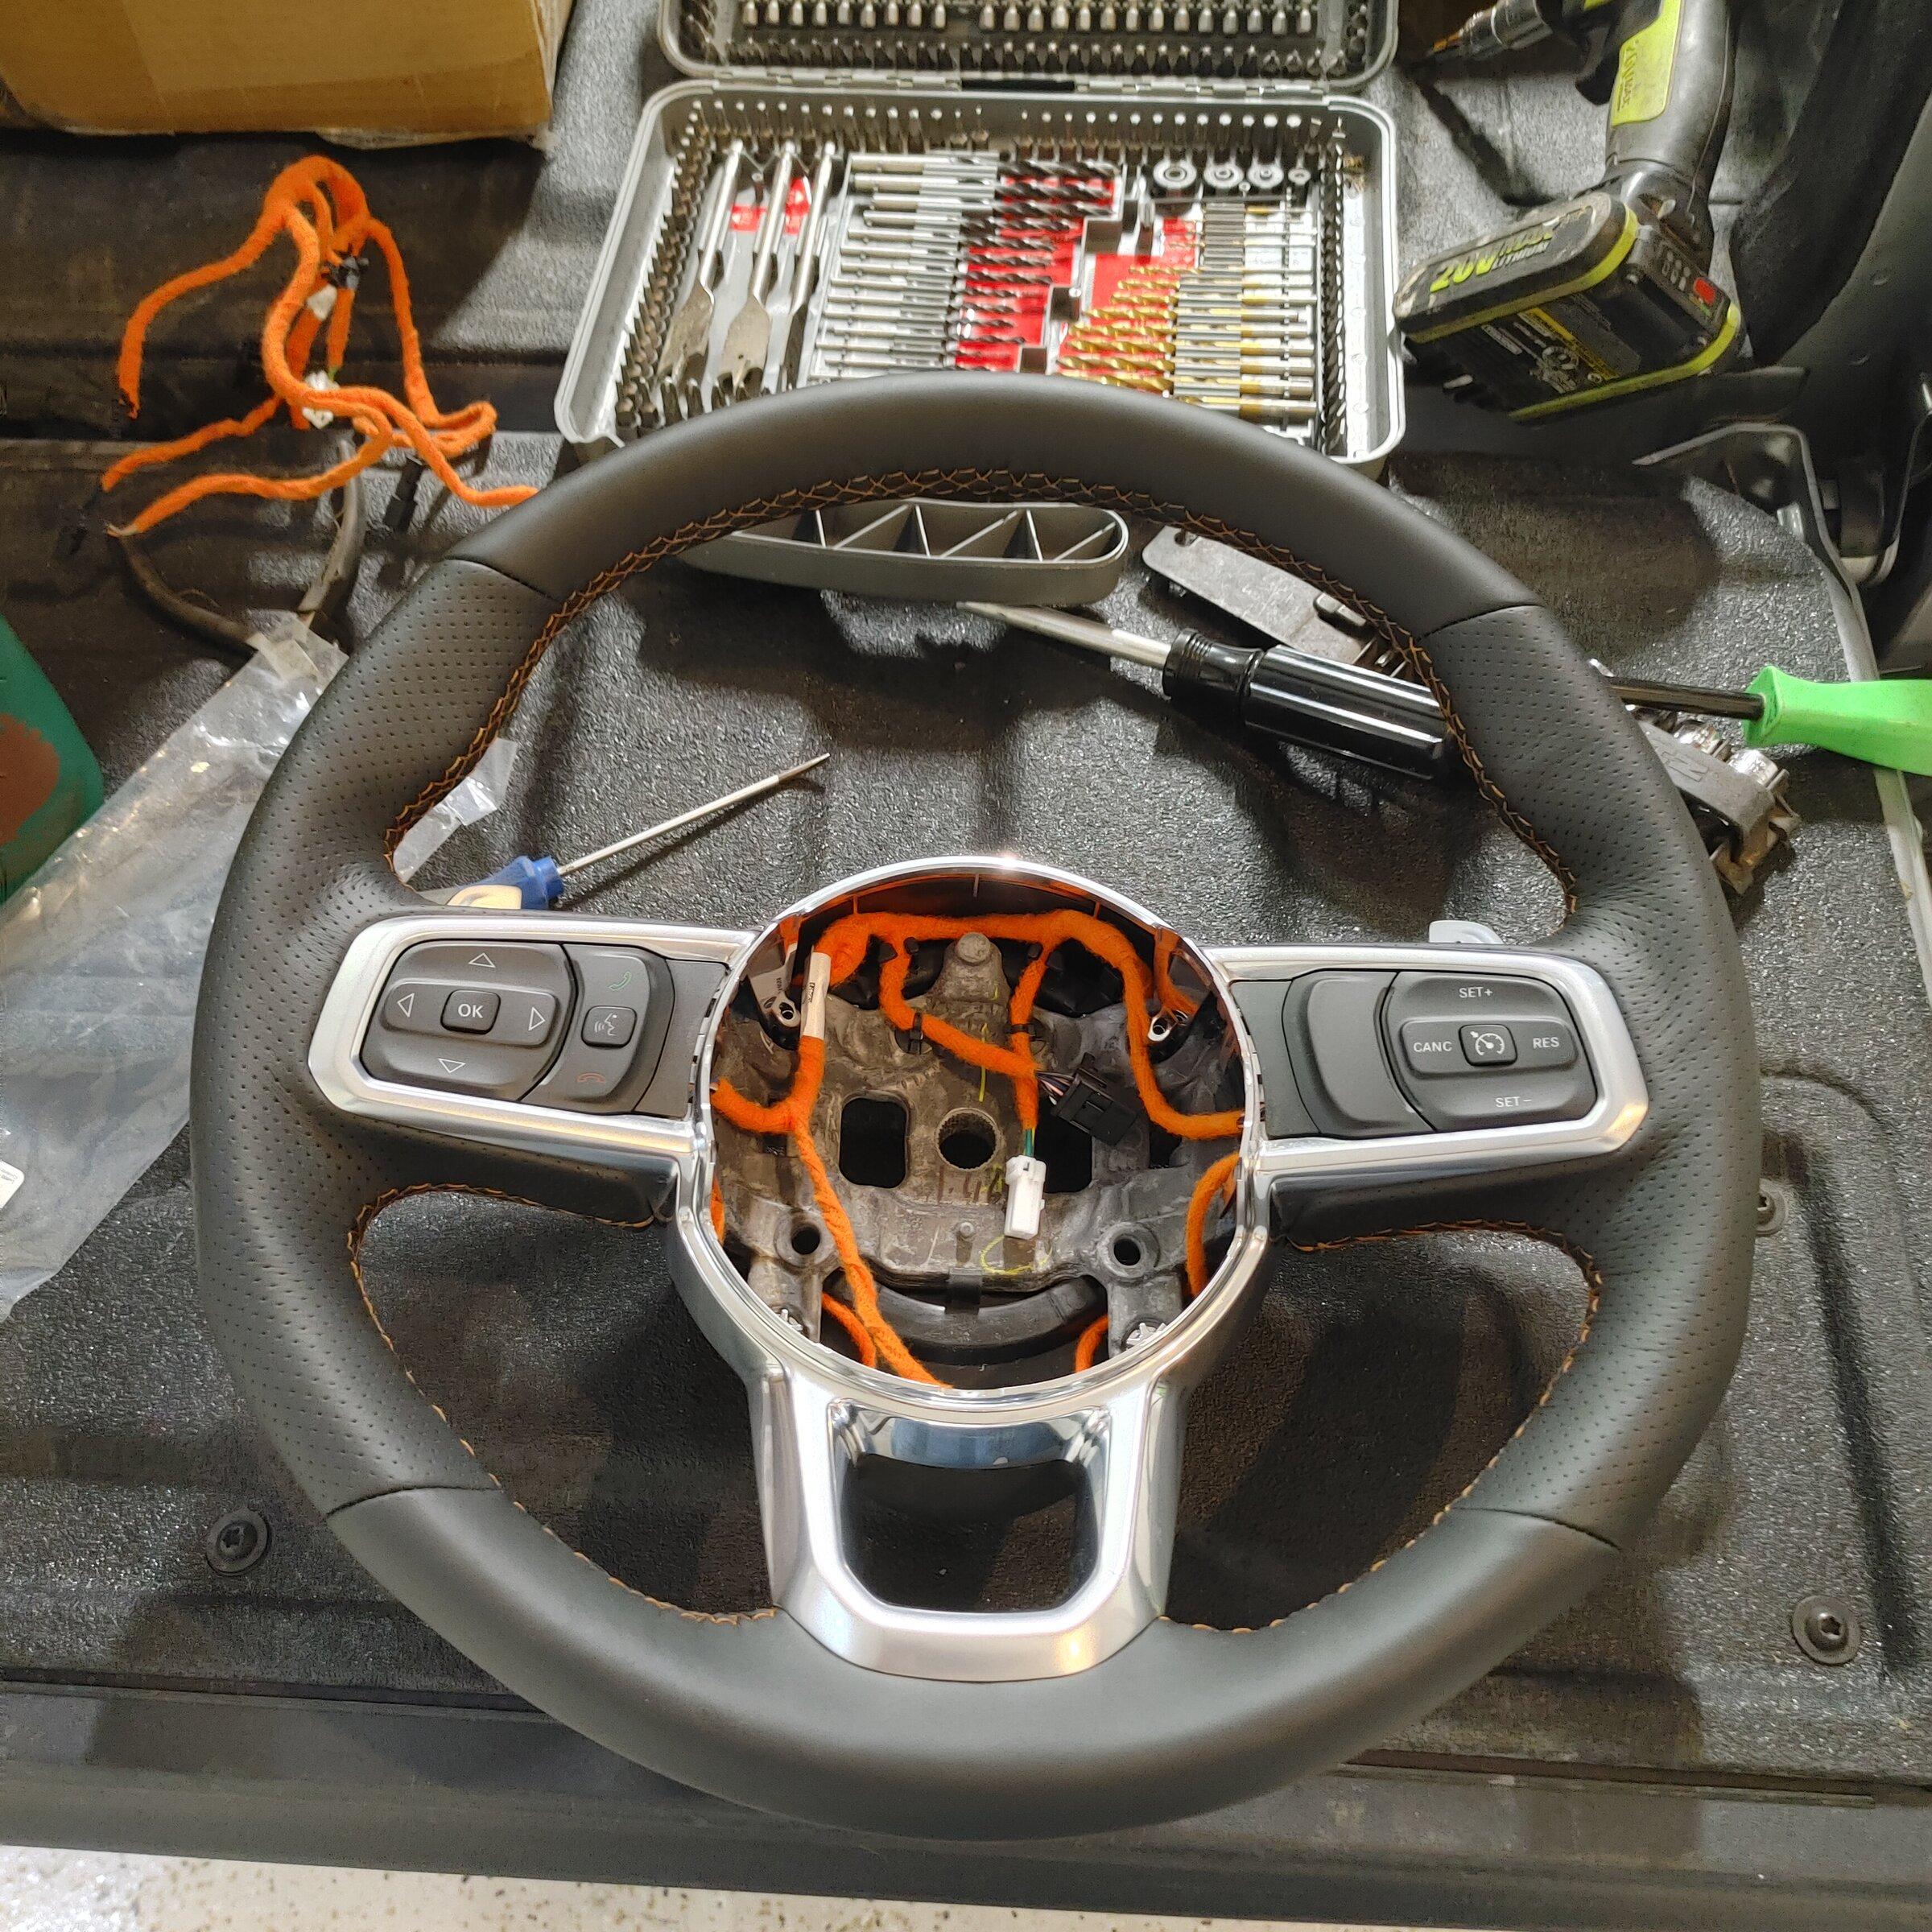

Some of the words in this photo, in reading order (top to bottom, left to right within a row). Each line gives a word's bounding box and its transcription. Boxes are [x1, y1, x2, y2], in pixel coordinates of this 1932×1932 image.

[1459, 986, 1493, 999] SET+
[457, 1003, 484, 1019] OK
[1413, 1041, 1453, 1052] CANC
[1533, 1036, 1560, 1049] RES
